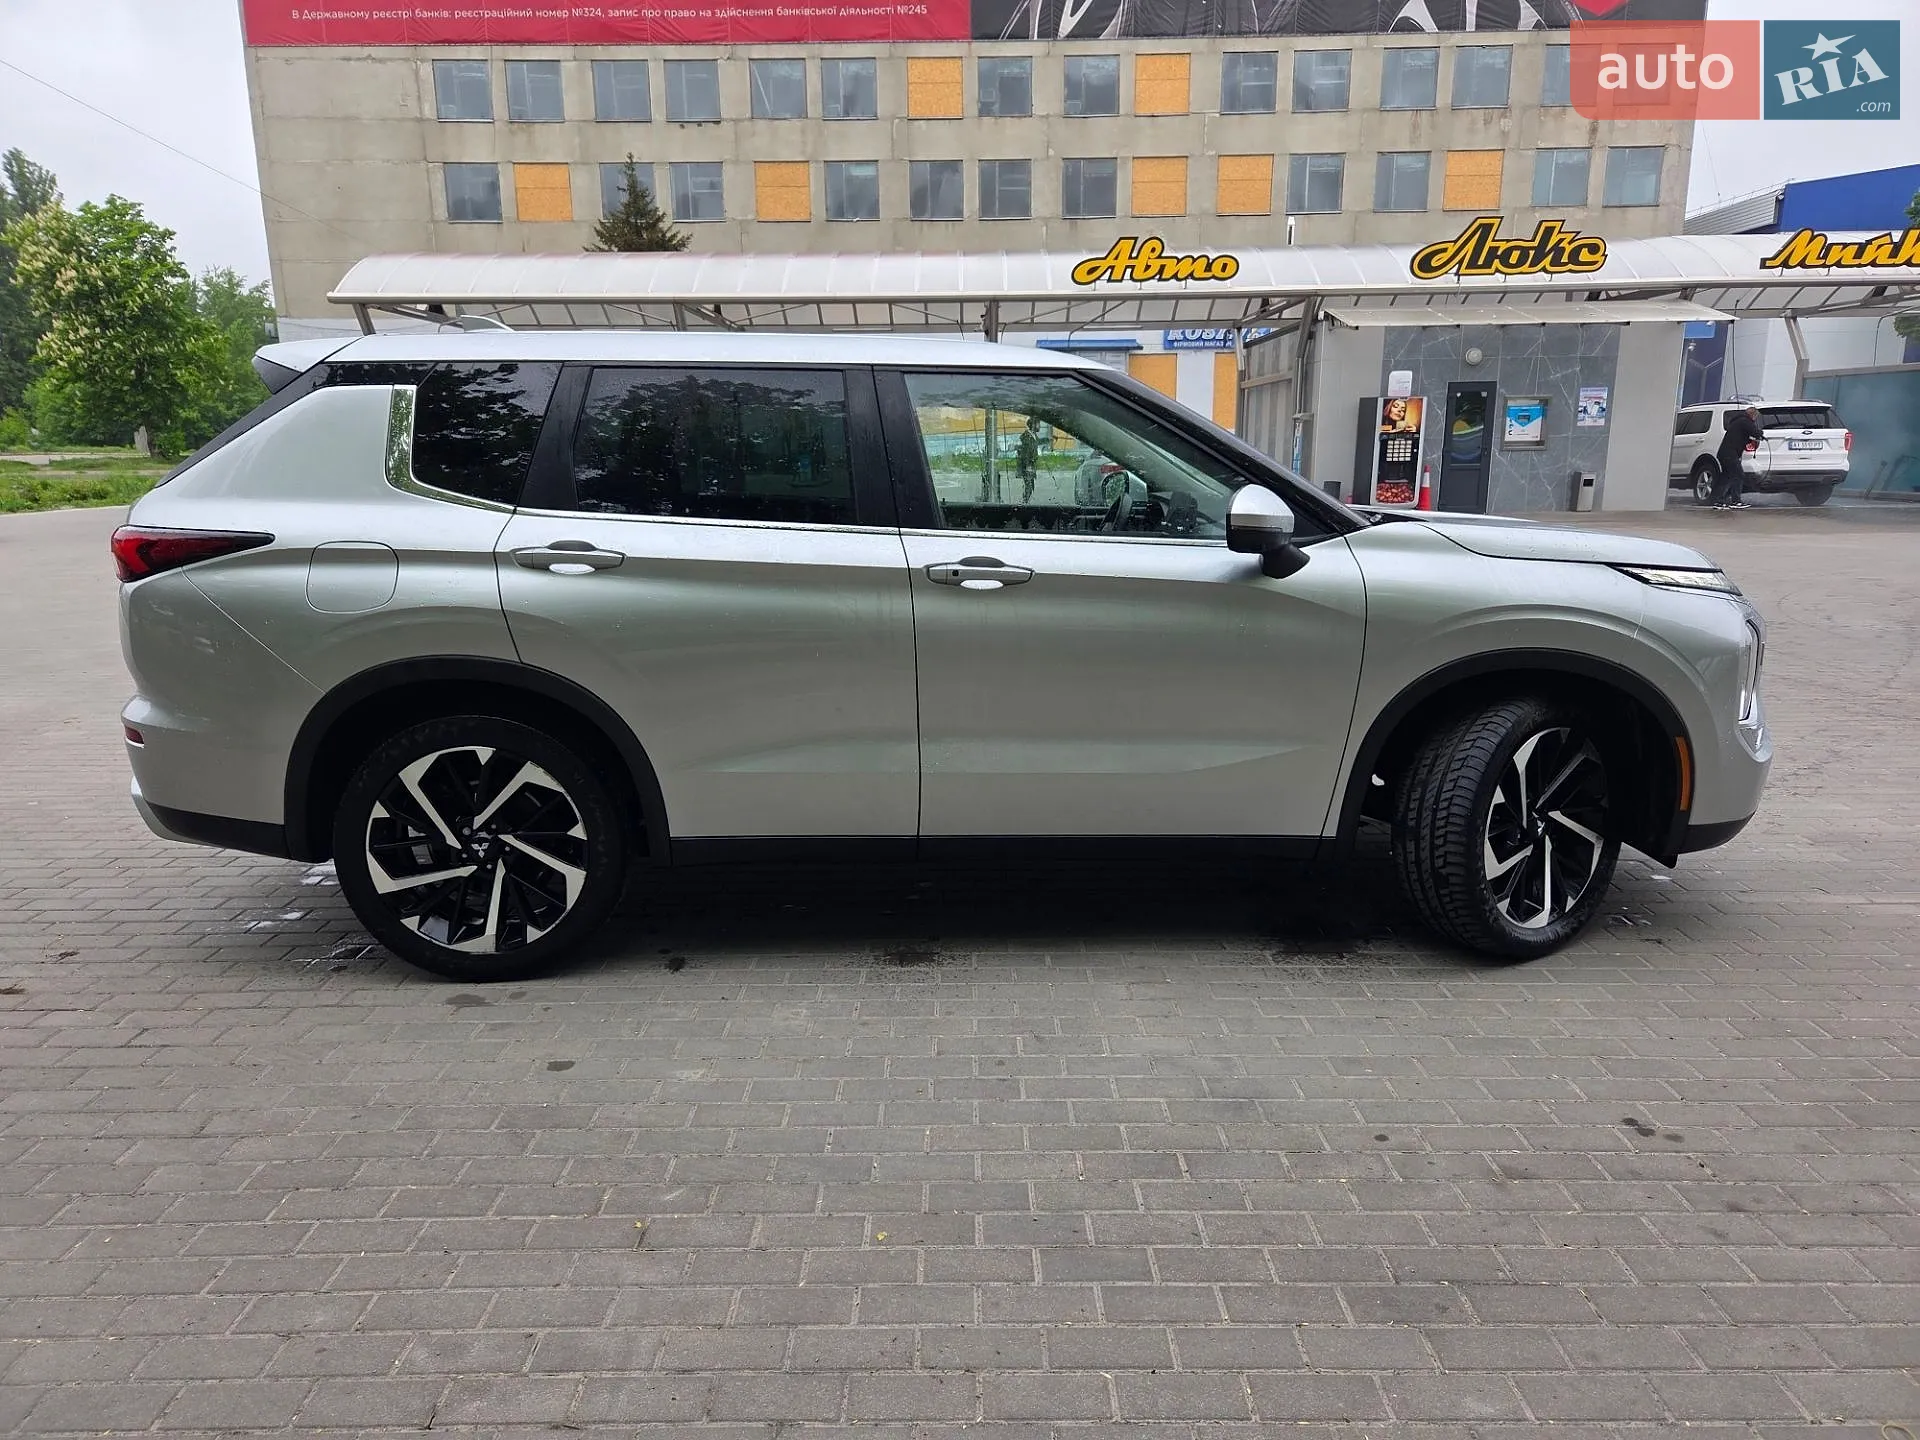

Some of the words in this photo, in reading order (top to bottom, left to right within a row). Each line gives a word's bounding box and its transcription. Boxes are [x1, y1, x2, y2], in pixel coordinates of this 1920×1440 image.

[292, 9, 300, 19] В
[302, 9, 369, 20] Державному
[373, 9, 412, 20] реєстрі
[415, 8, 451, 18] банків:
[454, 8, 533, 19] реєстраційний
[536, 9, 568, 19] номер
[572, 8, 604, 18] №324,
[607, 9, 638, 17] запис
[641, 9, 662, 19] про
[664, 9, 696, 19] право
[699, 8, 712, 17] на
[714, 7, 773, 18] здійснення
[776, 6, 837, 16] банківської
[839, 6, 894, 17] діяльності
[897, 5, 928, 15] №245
[1071, 236, 1239, 285] Авто
[1410, 216, 1608, 279] Люкс
